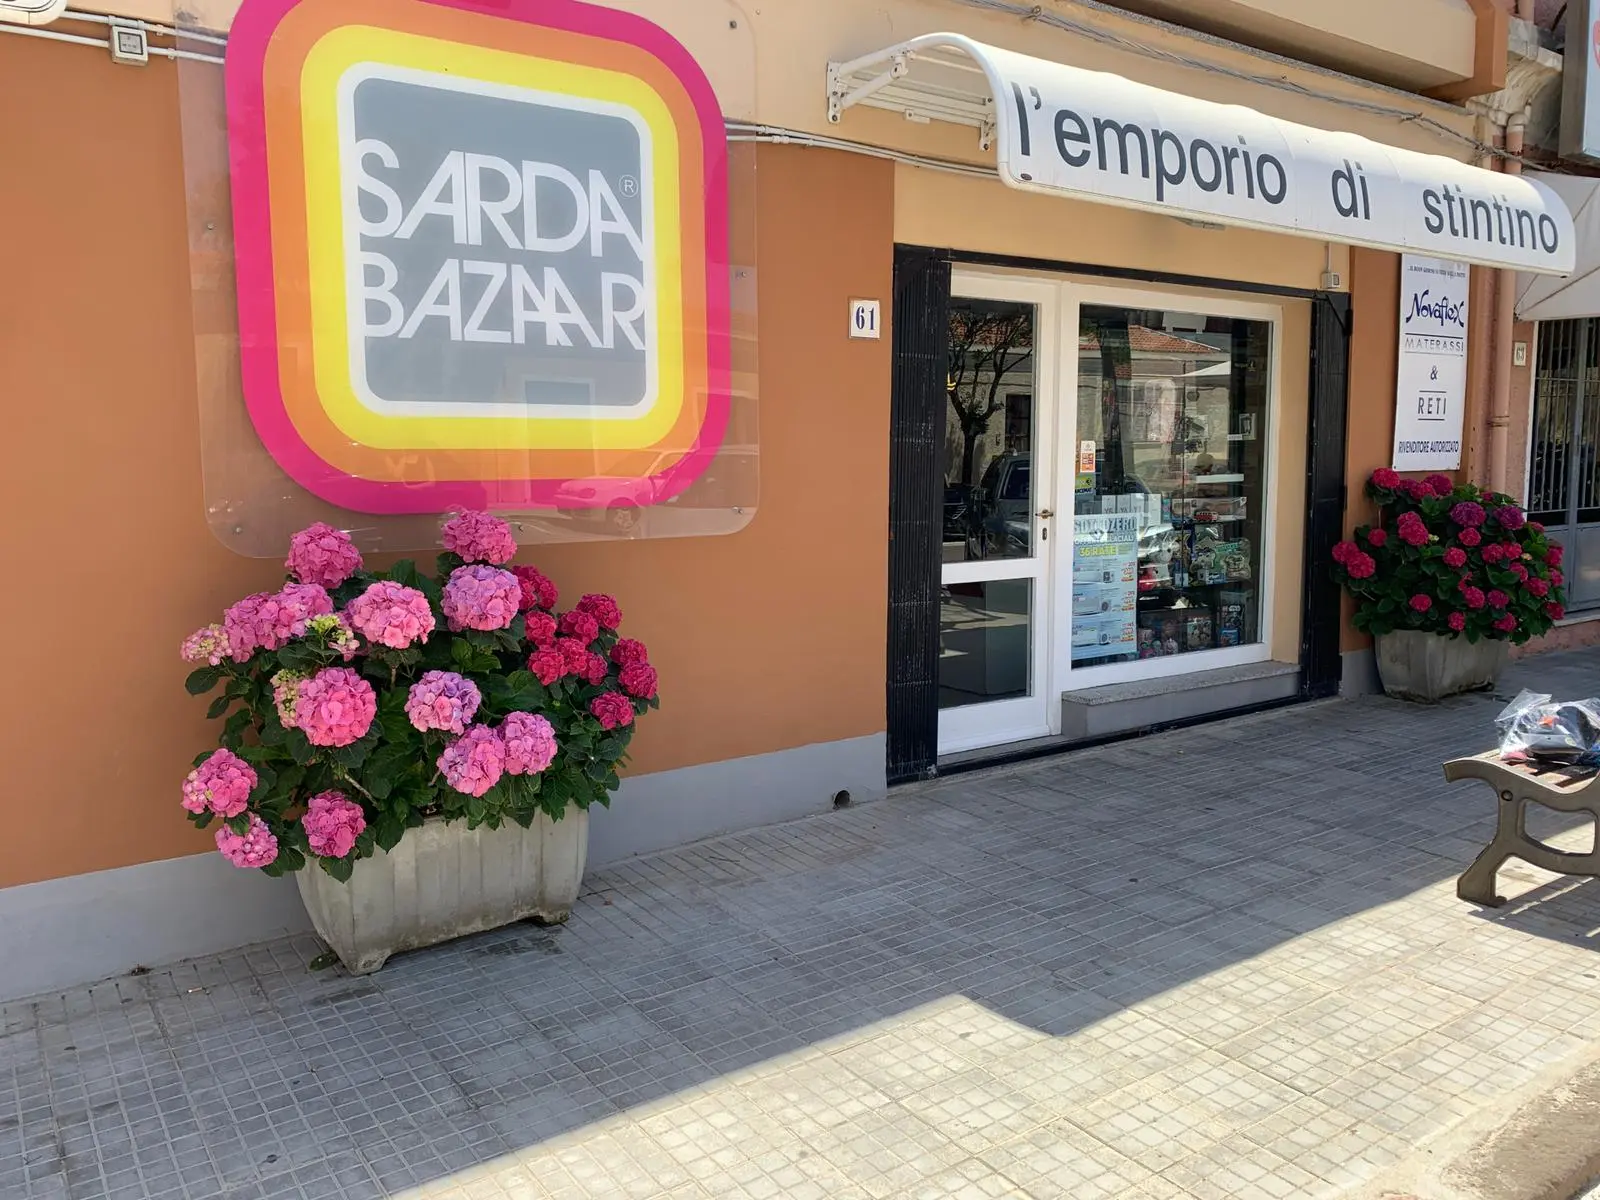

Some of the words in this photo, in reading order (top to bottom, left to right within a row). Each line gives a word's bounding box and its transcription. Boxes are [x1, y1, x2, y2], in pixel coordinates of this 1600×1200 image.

[1011, 81, 1287, 205] l'emporio
[1331, 158, 1371, 221] di
[1422, 184, 1559, 254] stintino
[355, 138, 643, 261] SARDA
[359, 250, 646, 351] BAZAAR
[855, 305, 875, 330] 61
[1404, 337, 1464, 352] MATERASSI
[1430, 365, 1438, 380] &
[1417, 397, 1447, 415] RETI
[1398, 440, 1430, 454] RIVENDITORE
[1430, 440, 1460, 454] AUTORIZZATO
